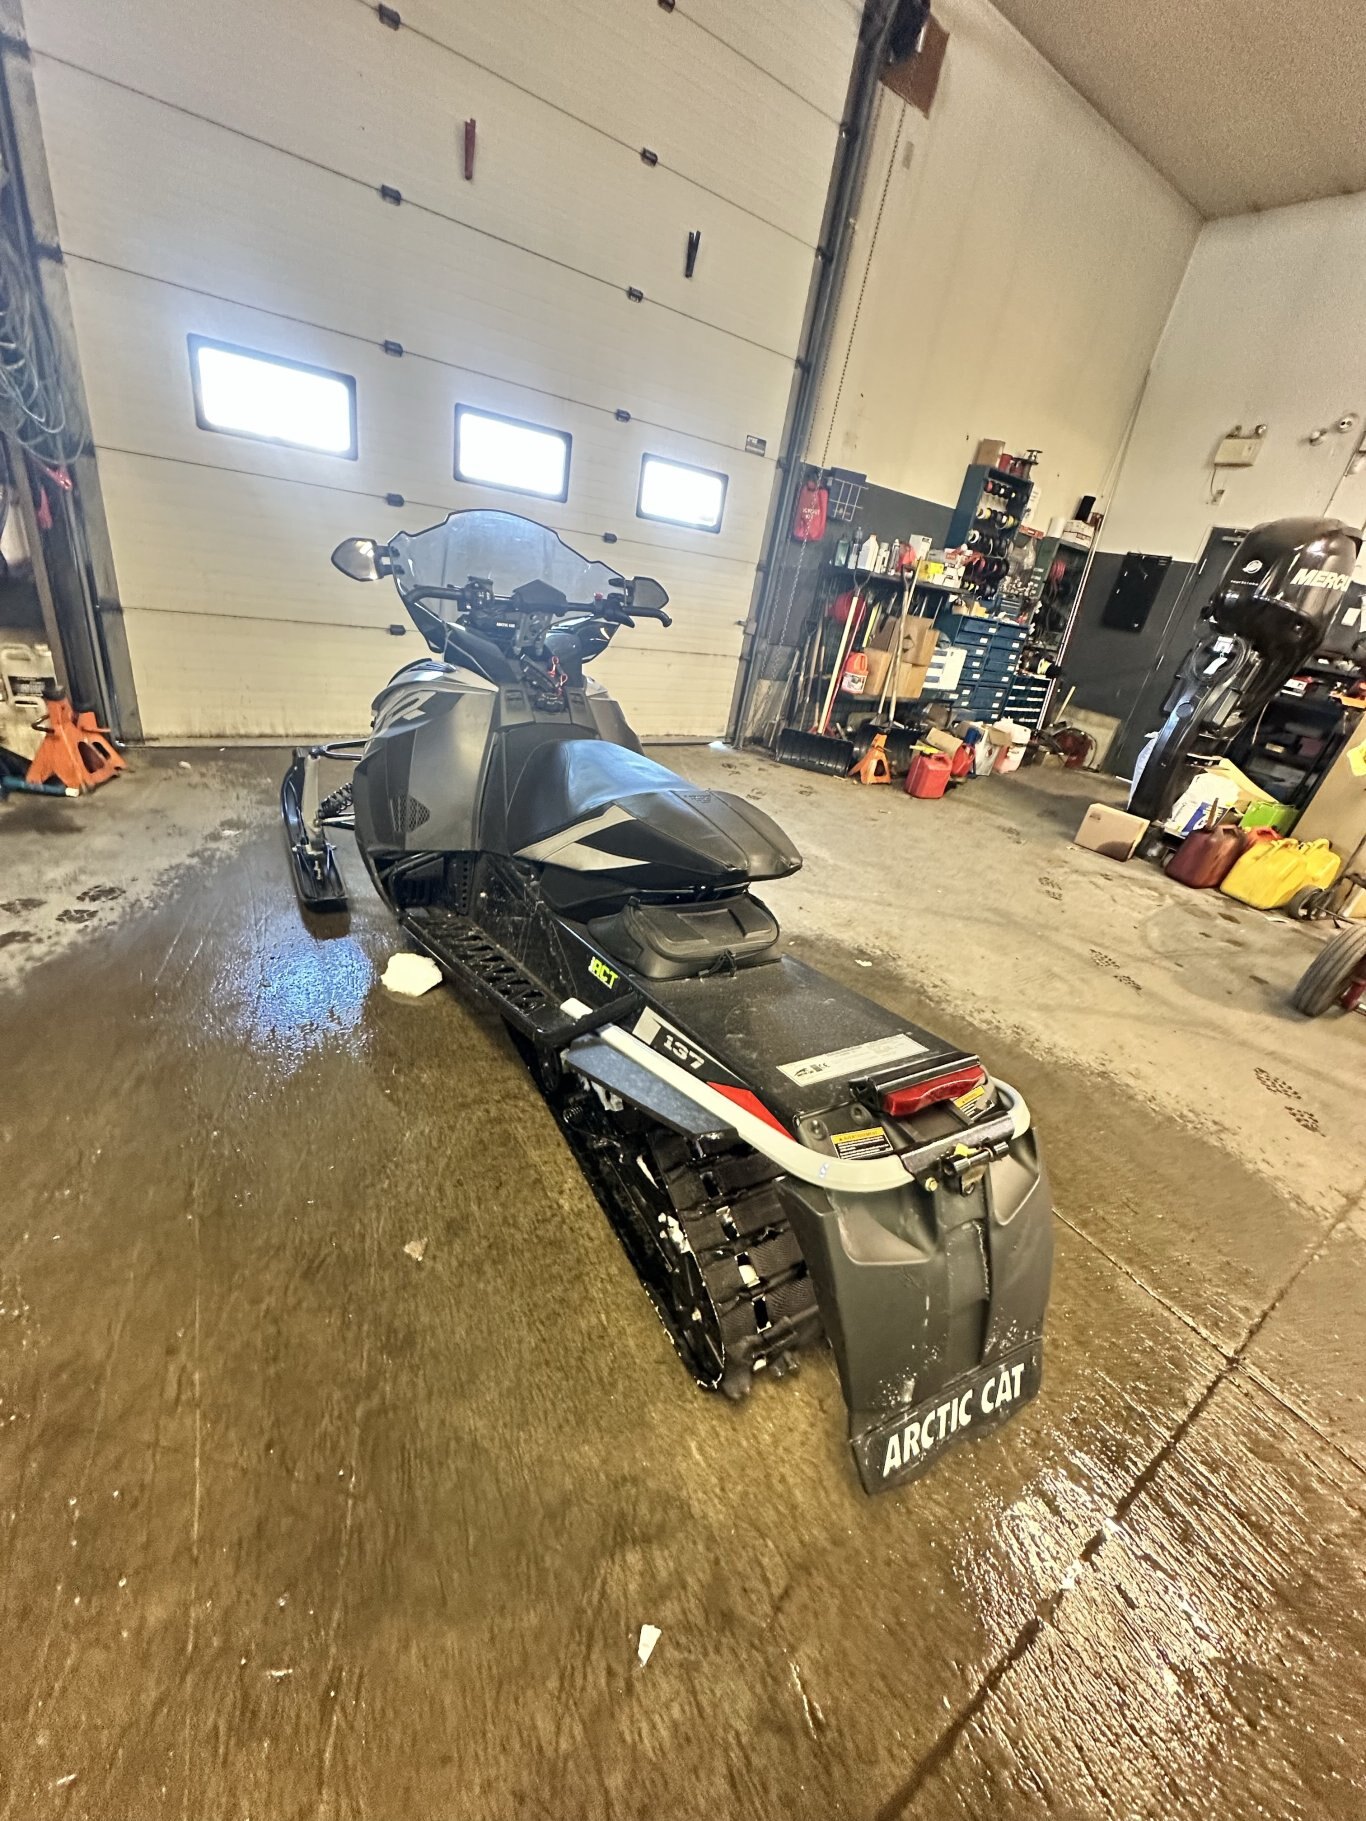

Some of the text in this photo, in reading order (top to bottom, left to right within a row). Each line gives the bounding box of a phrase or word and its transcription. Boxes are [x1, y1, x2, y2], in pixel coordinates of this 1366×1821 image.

[663, 1034, 705, 1070] 137
[882, 1362, 1025, 1478] ARCTIC CAT
